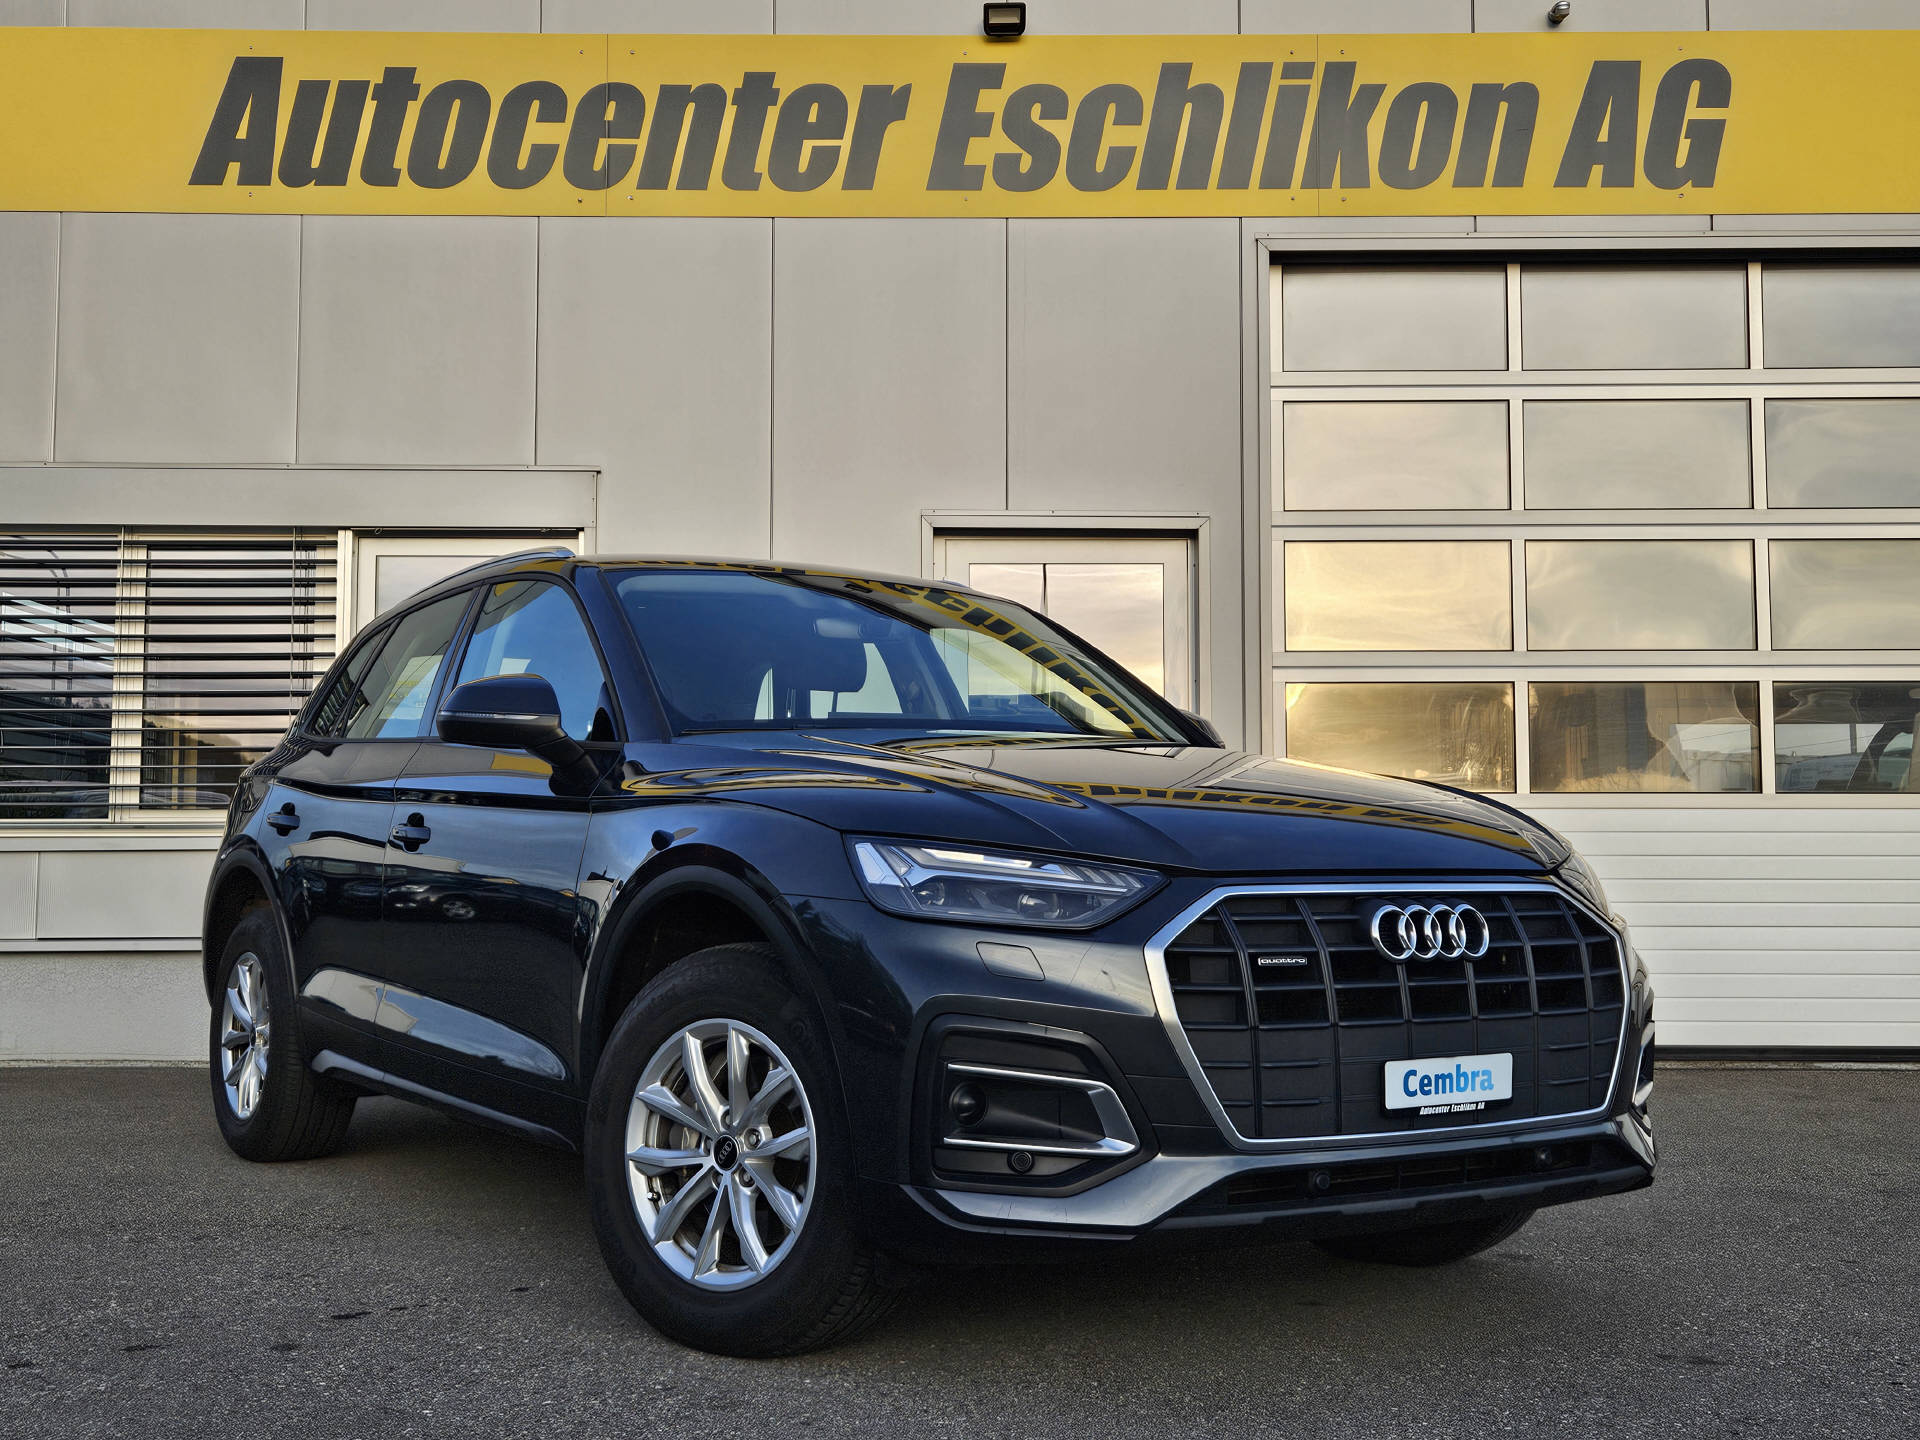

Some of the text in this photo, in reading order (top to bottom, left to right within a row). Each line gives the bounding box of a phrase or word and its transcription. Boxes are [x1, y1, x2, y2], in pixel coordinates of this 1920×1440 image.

[188, 56, 1732, 192] Autocenter Eschlikon AG
[1260, 957, 1306, 965] quattro
[1403, 1064, 1494, 1097] Cembra
